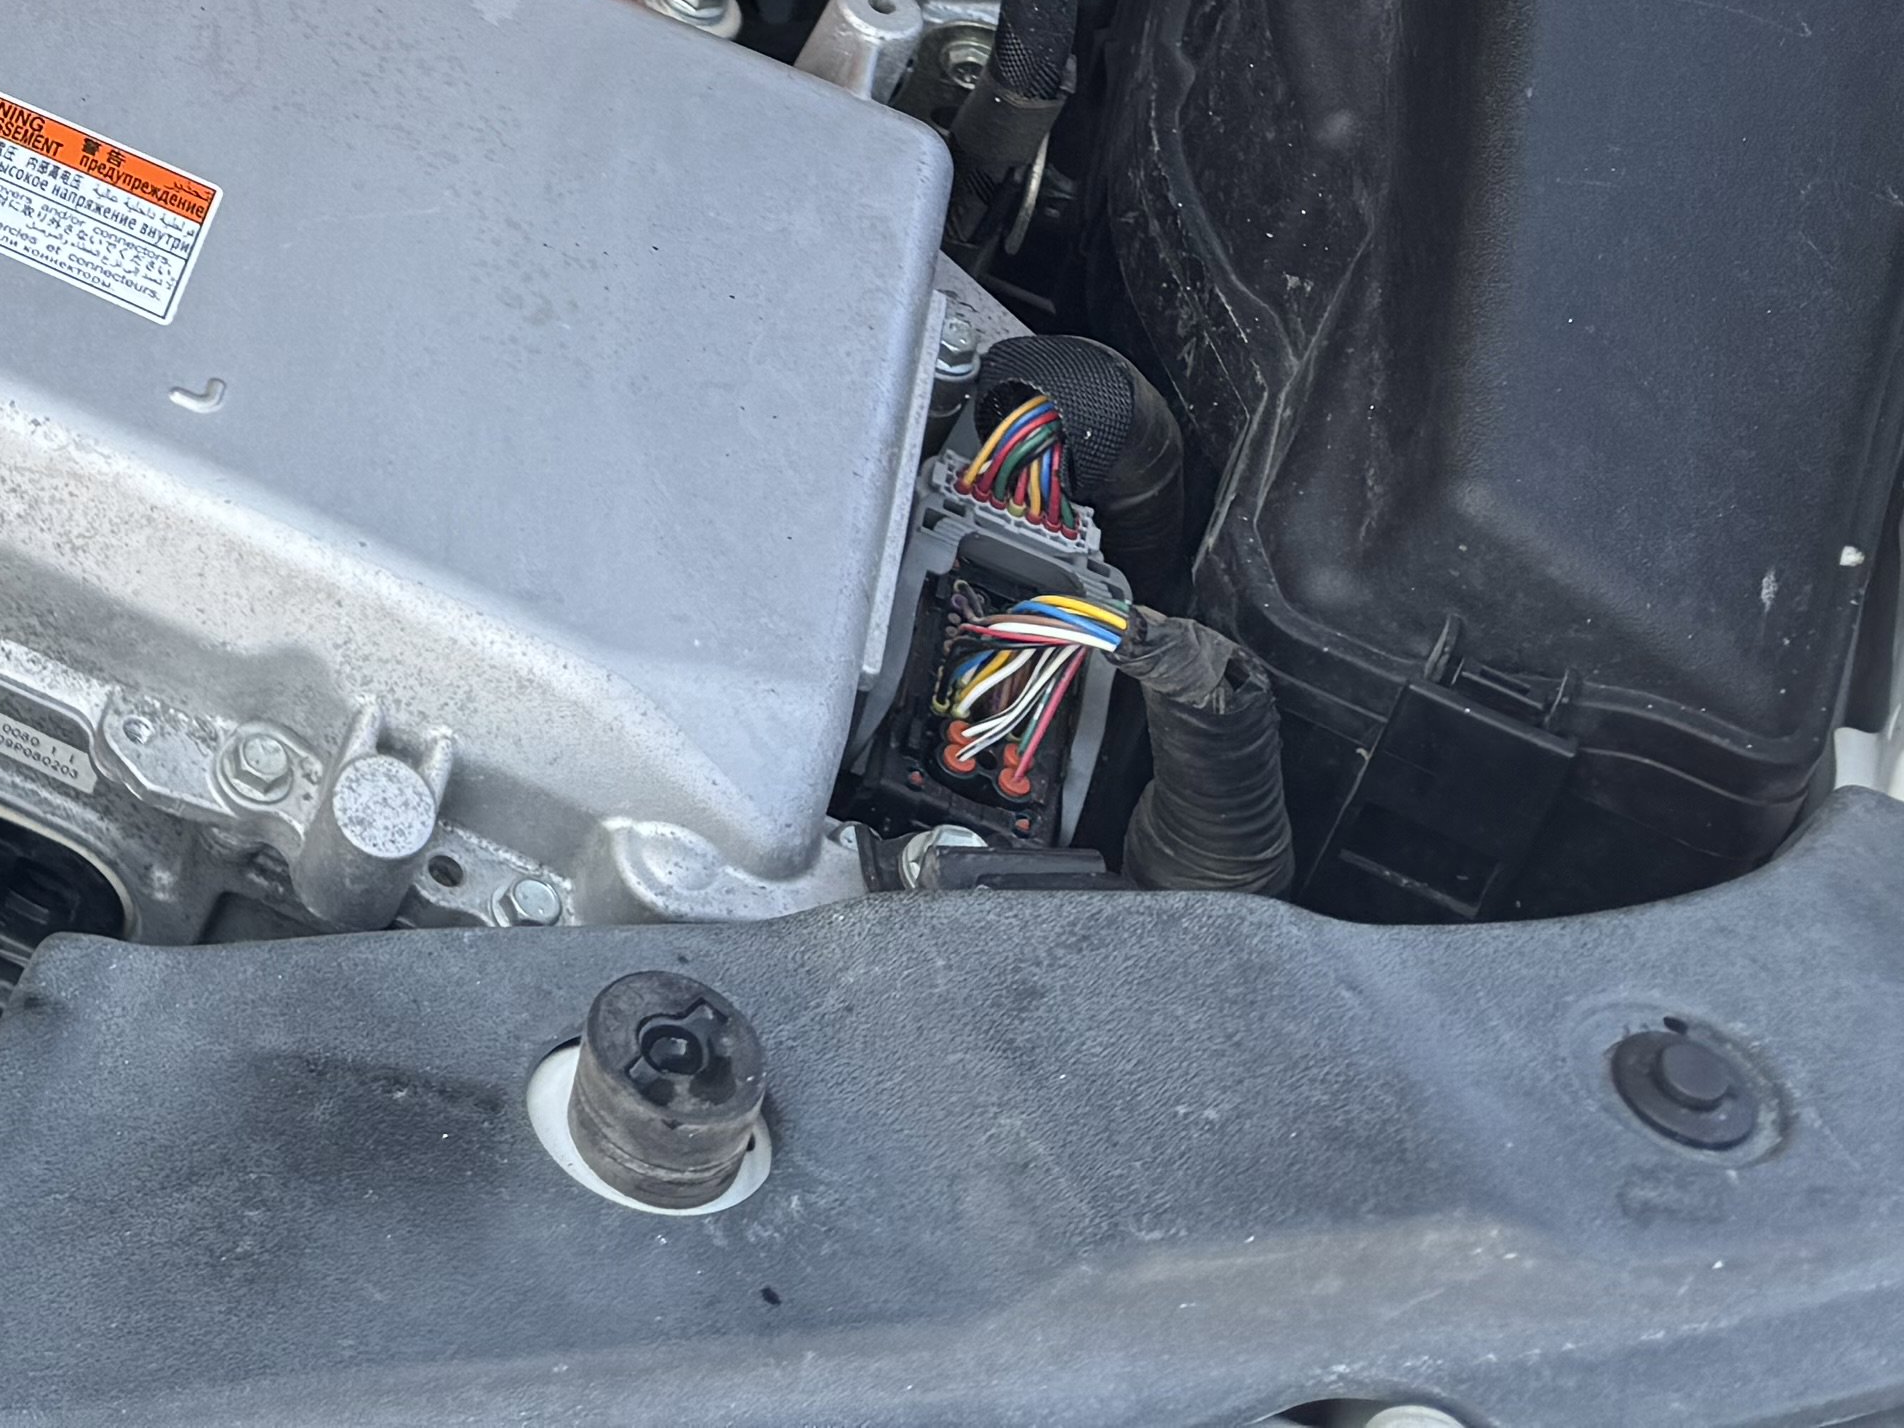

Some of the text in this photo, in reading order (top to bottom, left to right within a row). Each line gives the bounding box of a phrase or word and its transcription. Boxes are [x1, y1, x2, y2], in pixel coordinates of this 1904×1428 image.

[78, 136, 128, 169] 警告
[76, 152, 207, 222] предупреждение
[39, 201, 86, 229] and/or
[48, 183, 138, 234] напряжение
[136, 221, 192, 258] внутри
[43, 241, 62, 257] et
